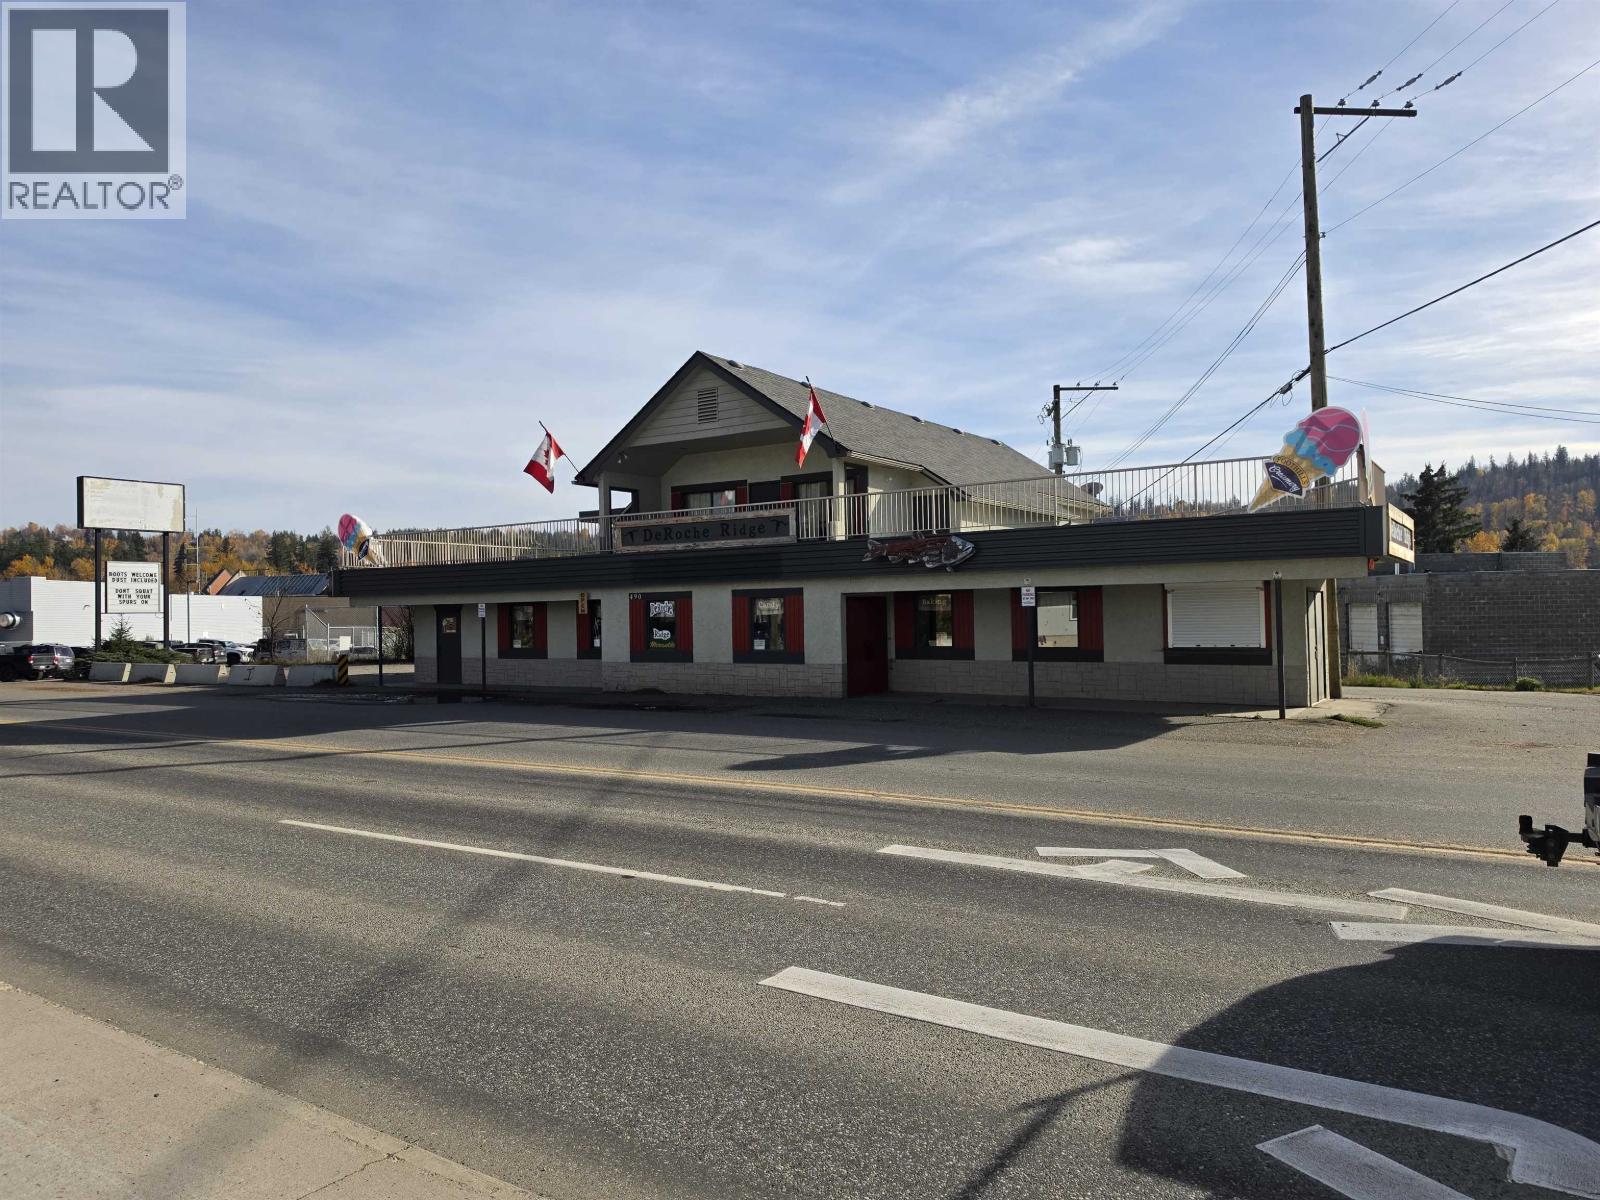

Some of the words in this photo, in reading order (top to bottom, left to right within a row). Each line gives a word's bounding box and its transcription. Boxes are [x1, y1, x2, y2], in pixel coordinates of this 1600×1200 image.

[1269, 465, 1300, 492] Creamery
[643, 527, 713, 542] DeRoche
[720, 522, 766, 537] Ridge
[653, 628, 671, 641] Ridge
